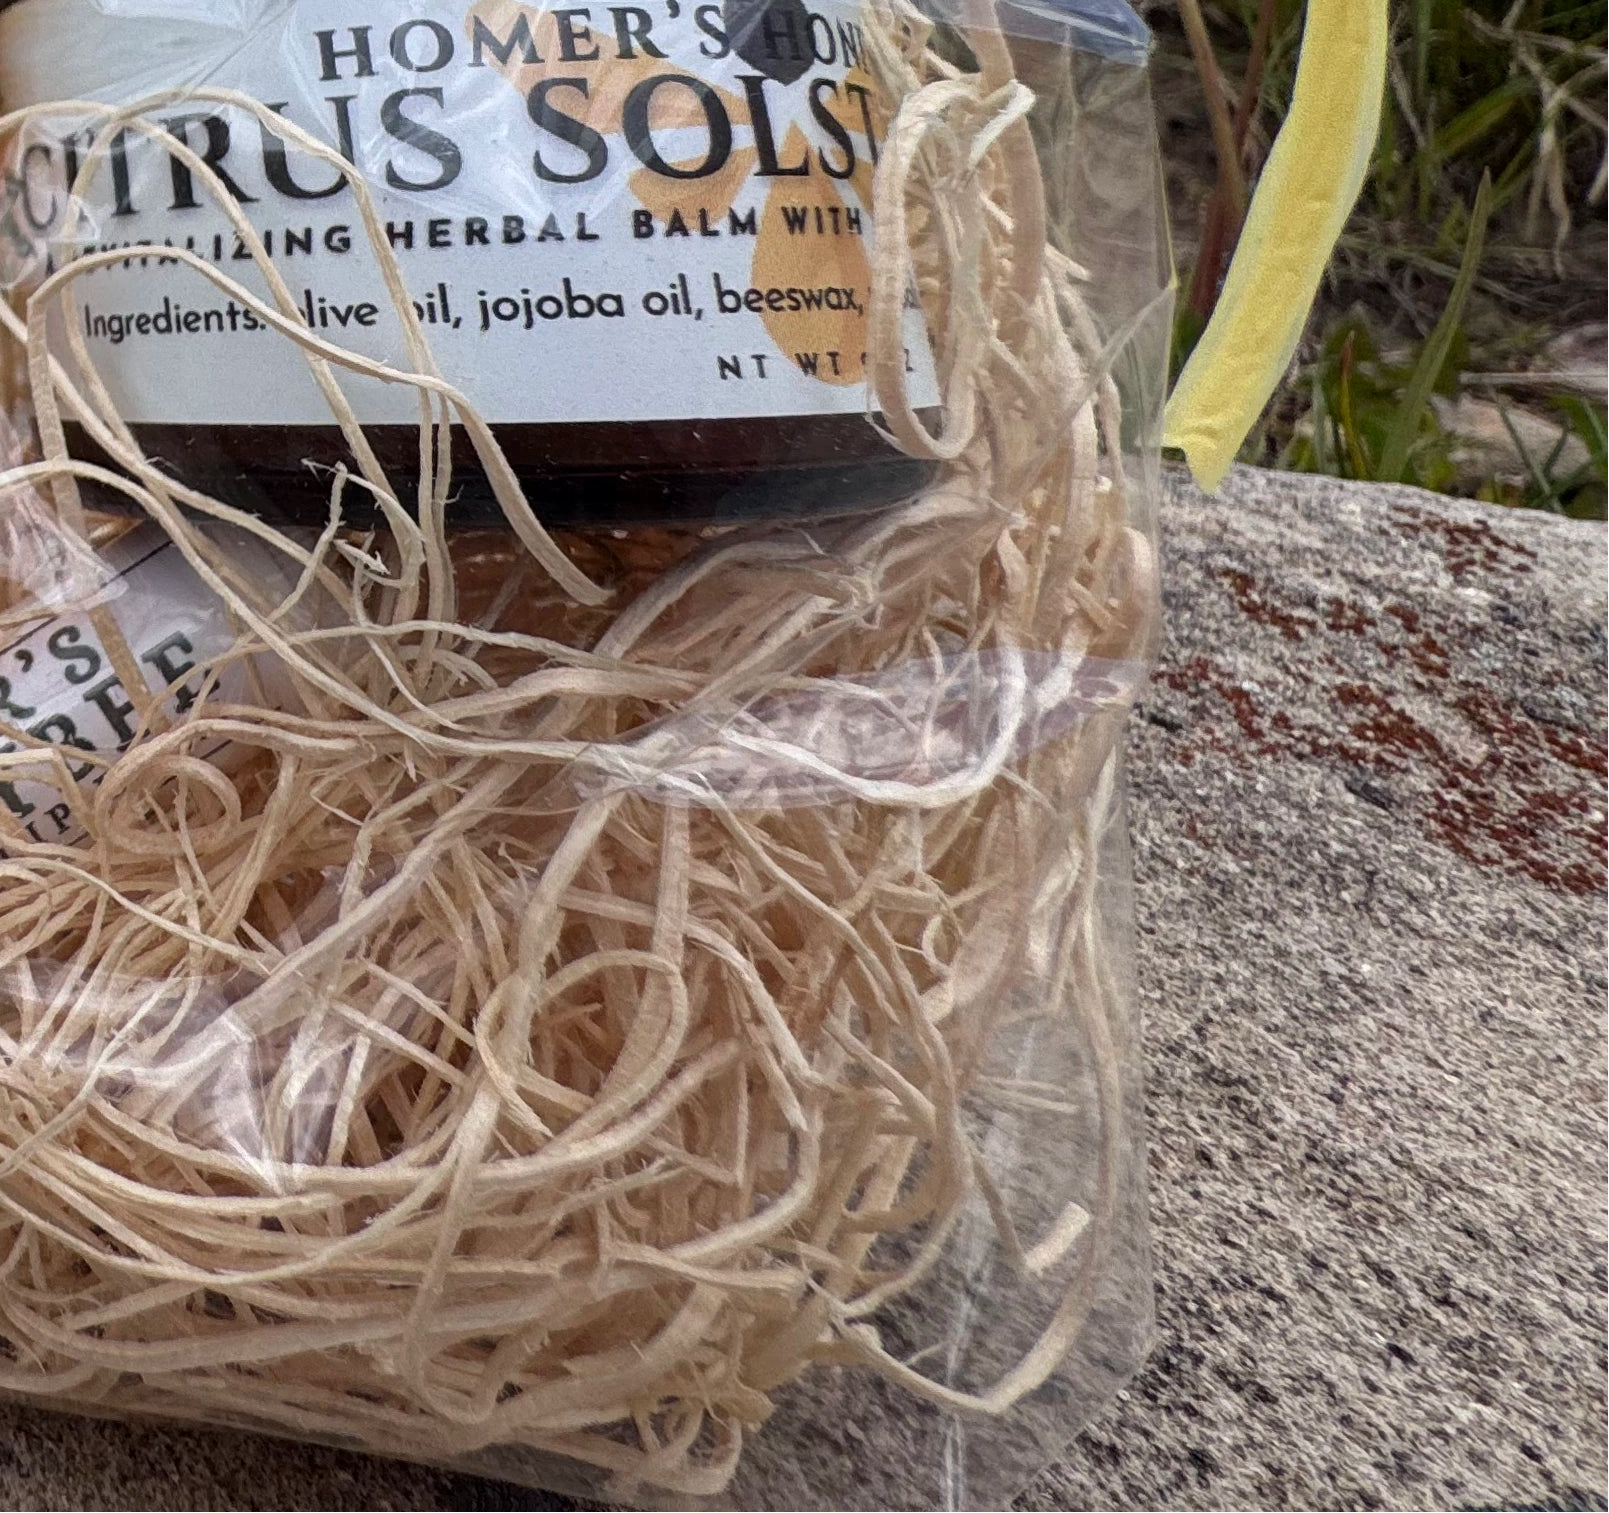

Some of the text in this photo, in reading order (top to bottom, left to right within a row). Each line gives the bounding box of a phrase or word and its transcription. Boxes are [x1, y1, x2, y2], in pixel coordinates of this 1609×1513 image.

[526, 73, 879, 183] SOLST
[385, 211, 600, 249] HERBAL
[633, 206, 757, 239] BALM
[780, 205, 863, 236] WITH
[298, 288, 379, 329] live
[477, 276, 626, 331] jojoba
[642, 273, 703, 320] oil,
[713, 272, 864, 317] beeswax,
